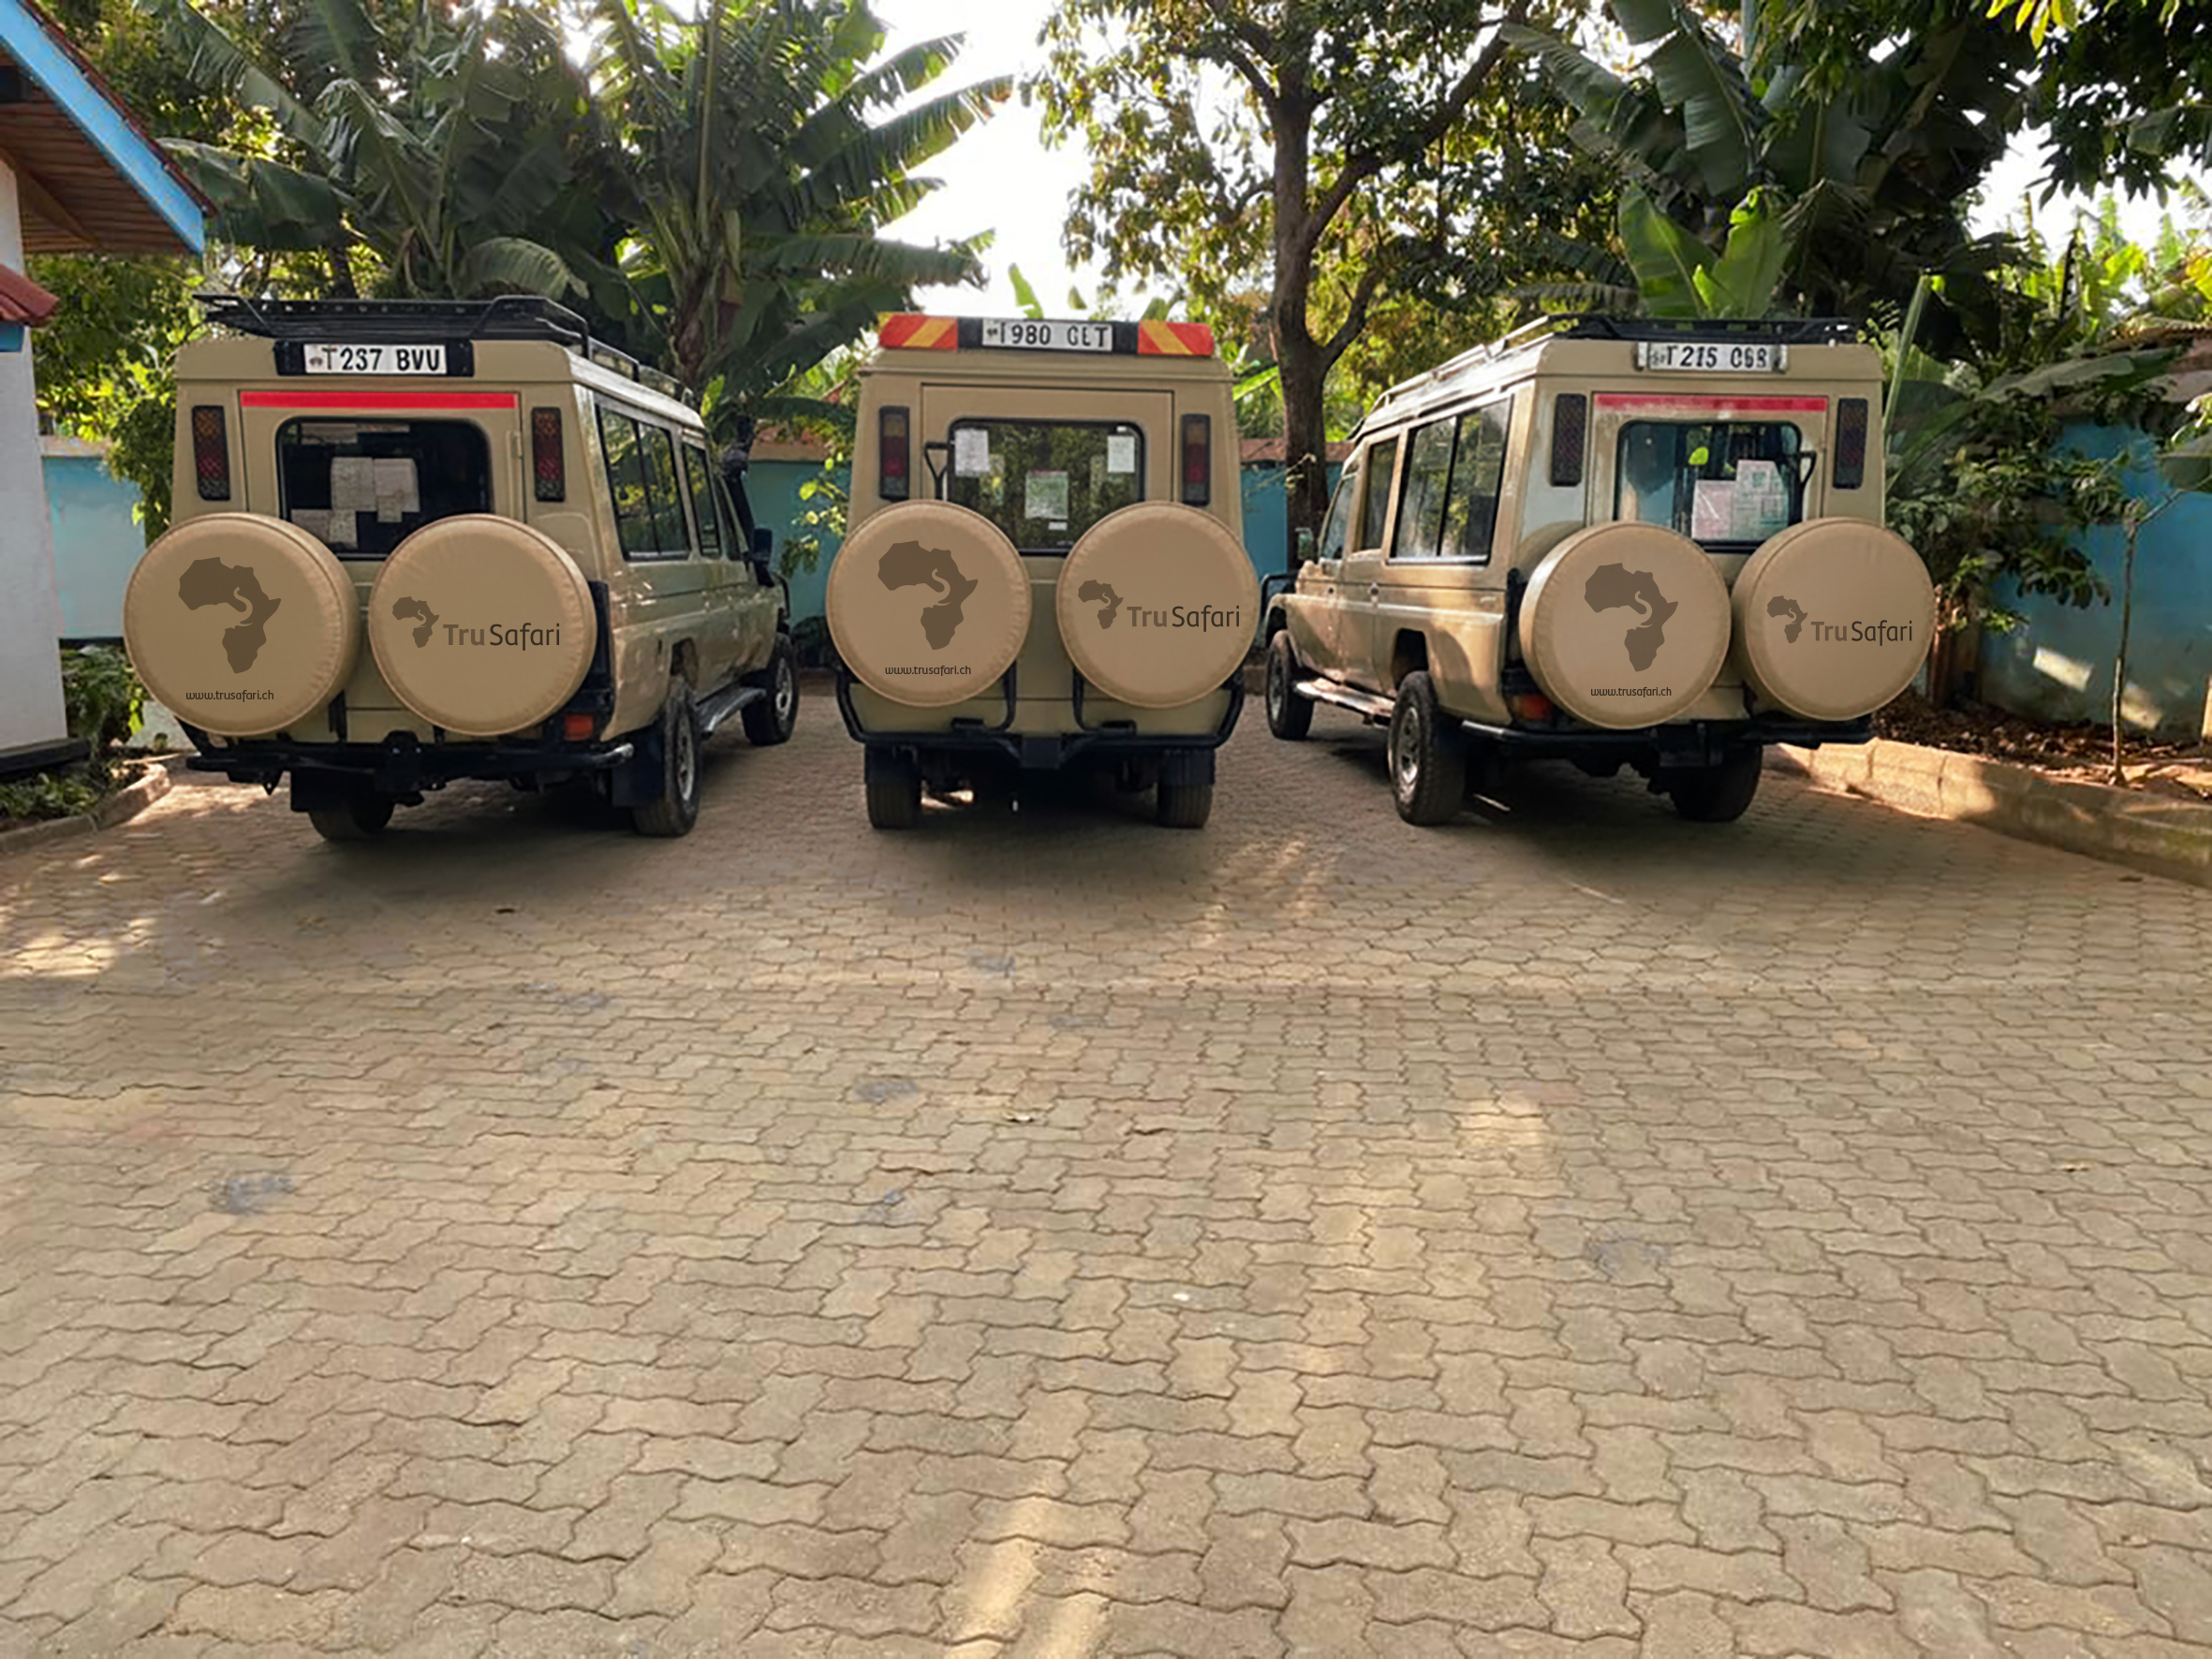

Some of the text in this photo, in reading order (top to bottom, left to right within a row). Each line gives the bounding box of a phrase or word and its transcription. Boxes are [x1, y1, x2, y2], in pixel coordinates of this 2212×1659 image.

[396, 348, 440, 372] BVU
[885, 665, 971, 677] www.trusafari.ch
[185, 689, 274, 703] www.trusafari.ch
[1590, 686, 1672, 698] www.trusafari.ch
